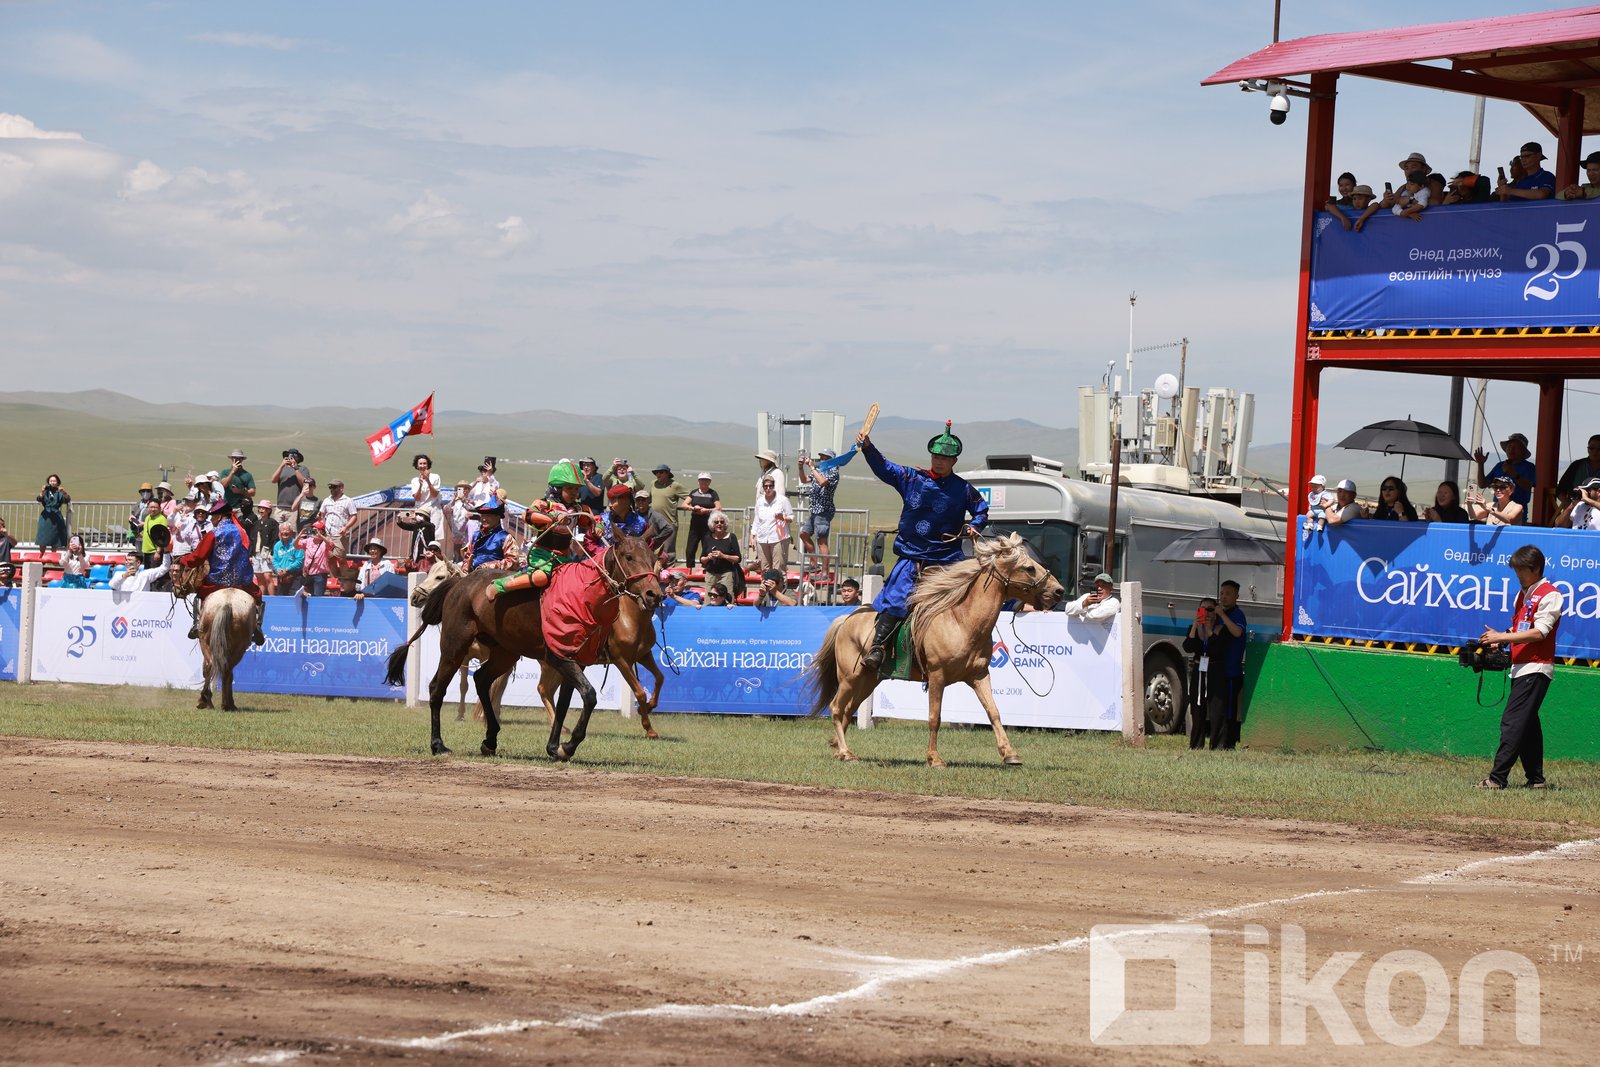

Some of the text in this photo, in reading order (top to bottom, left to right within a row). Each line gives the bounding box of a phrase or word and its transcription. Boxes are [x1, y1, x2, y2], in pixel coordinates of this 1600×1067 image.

[1409, 247, 1503, 262] Өнөд дэвжих,
[1523, 219, 1588, 301] 25
[1389, 267, 1502, 282] өсөлтийн түүчээ
[1444, 548, 1493, 563] Өөдлөн
[1356, 557, 1510, 613] Сайхан
[131, 619, 172, 628] CAPITRON
[67, 614, 97, 658] 25
[131, 630, 153, 639] BANK
[301, 637, 388, 661] наадаарай
[1014, 644, 1073, 656] CAPITRON
[660, 645, 815, 675] Сайхан наадаар
[1014, 657, 1045, 668] BANK
